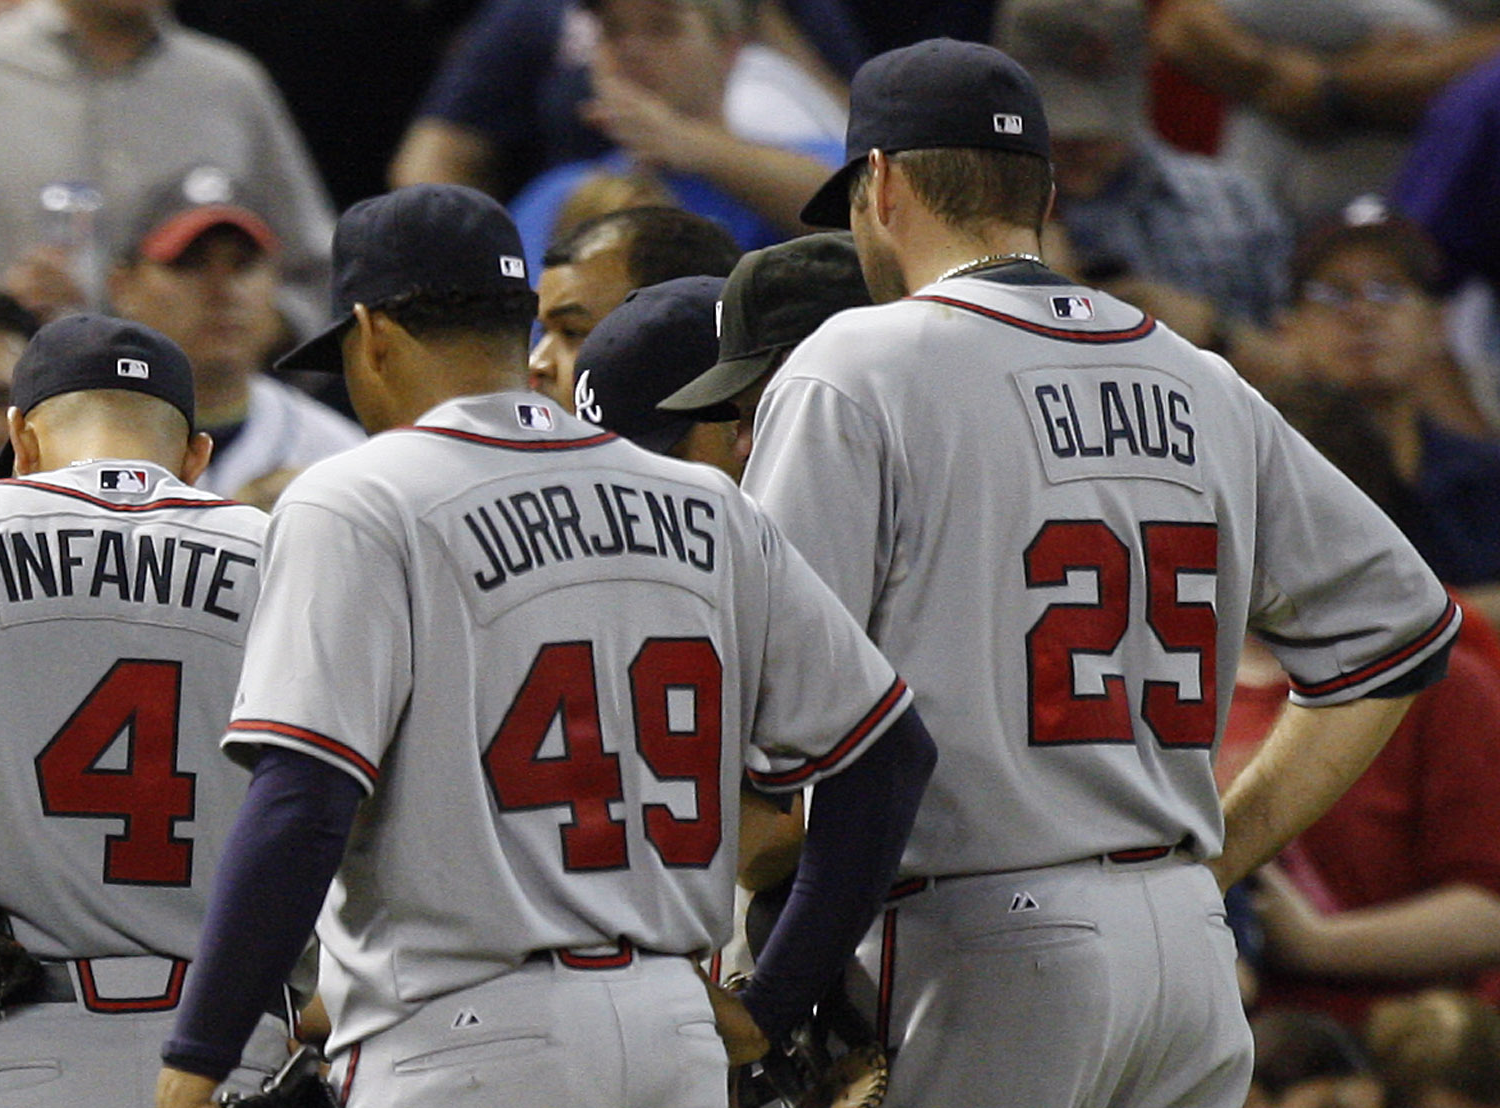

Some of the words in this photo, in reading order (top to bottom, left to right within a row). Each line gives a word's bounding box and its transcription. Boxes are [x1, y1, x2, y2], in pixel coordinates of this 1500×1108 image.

[464, 483, 716, 592] JURRJENS
[1034, 381, 1196, 467] GLAUS
[1022, 519, 1217, 751] 25
[34, 658, 197, 888] 4
[481, 637, 723, 873] 49
